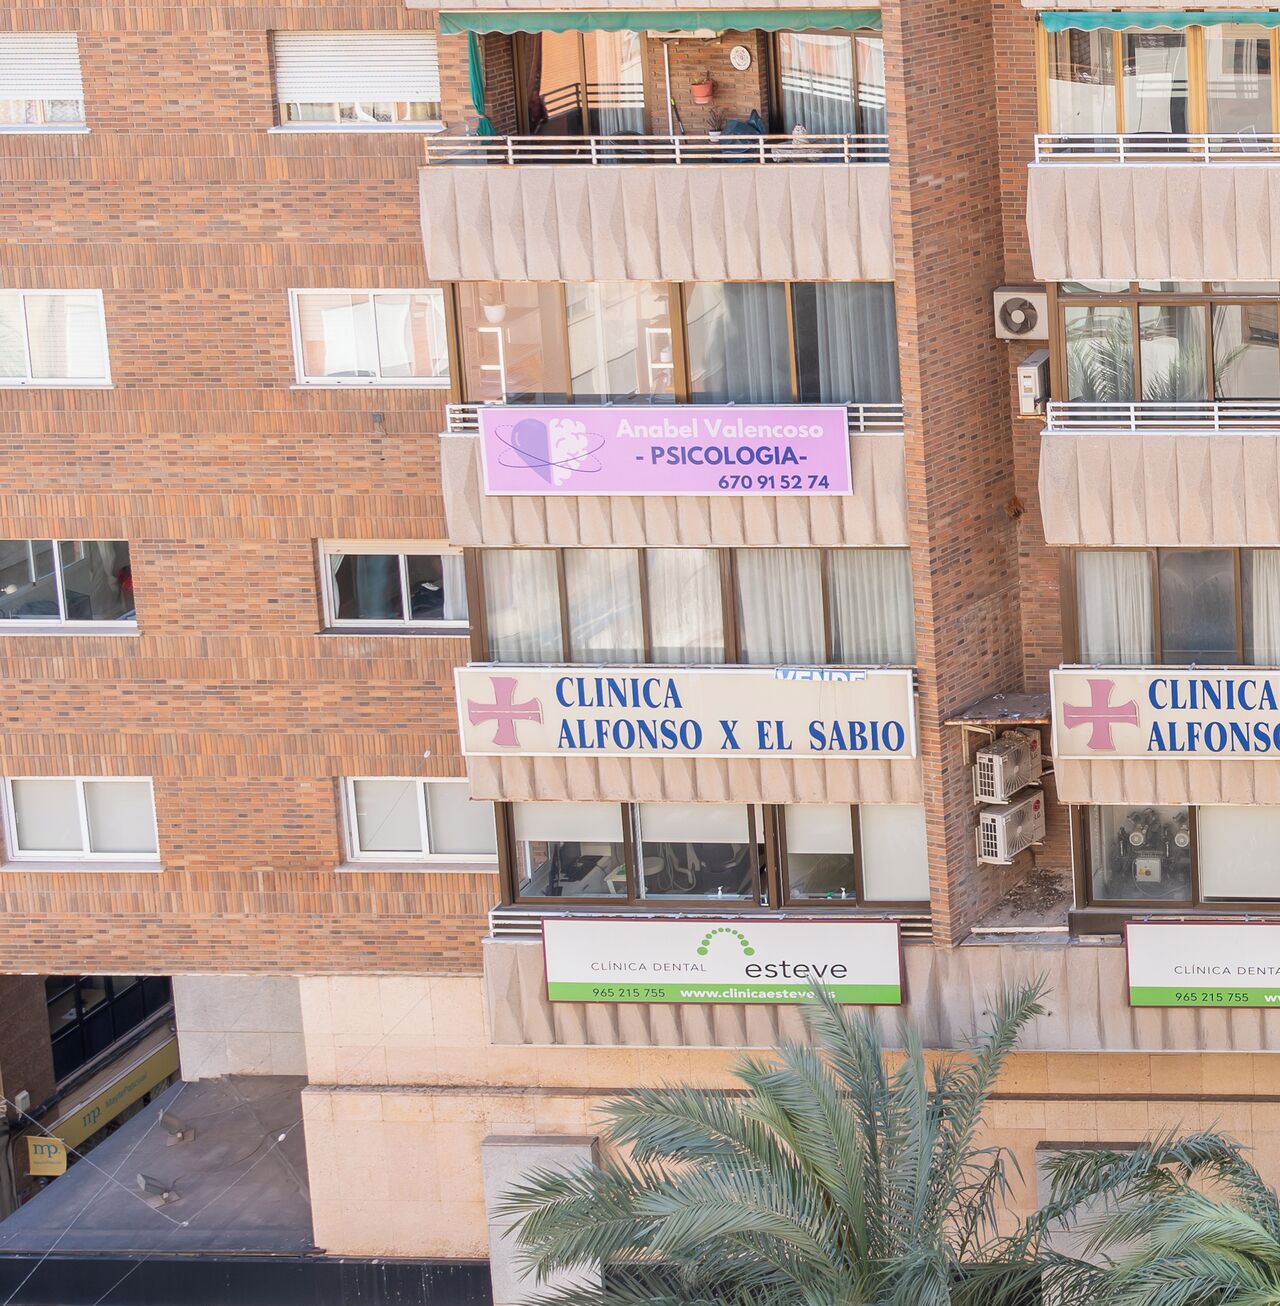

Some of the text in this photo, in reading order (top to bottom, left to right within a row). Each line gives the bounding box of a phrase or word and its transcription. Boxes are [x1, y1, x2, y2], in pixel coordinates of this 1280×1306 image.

[616, 418, 824, 439] Anabel Valencoso
[718, 474, 830, 490] 670 91 52 74
[555, 677, 683, 708] CLINICA
[1148, 679, 1279, 711] CLINICA
[558, 719, 905, 752] ALFONSO X EL SABIO
[591, 960, 707, 973] CLÍNICA DENTAL
[744, 959, 848, 980] esteve
[1174, 964, 1231, 976] CLÍNICA
[592, 986, 836, 1001] 965 215 755 www.clinicaesteve.s
[1175, 991, 1198, 1002] 965
[1201, 992, 1224, 1002] 215
[1226, 992, 1249, 1003] 755
